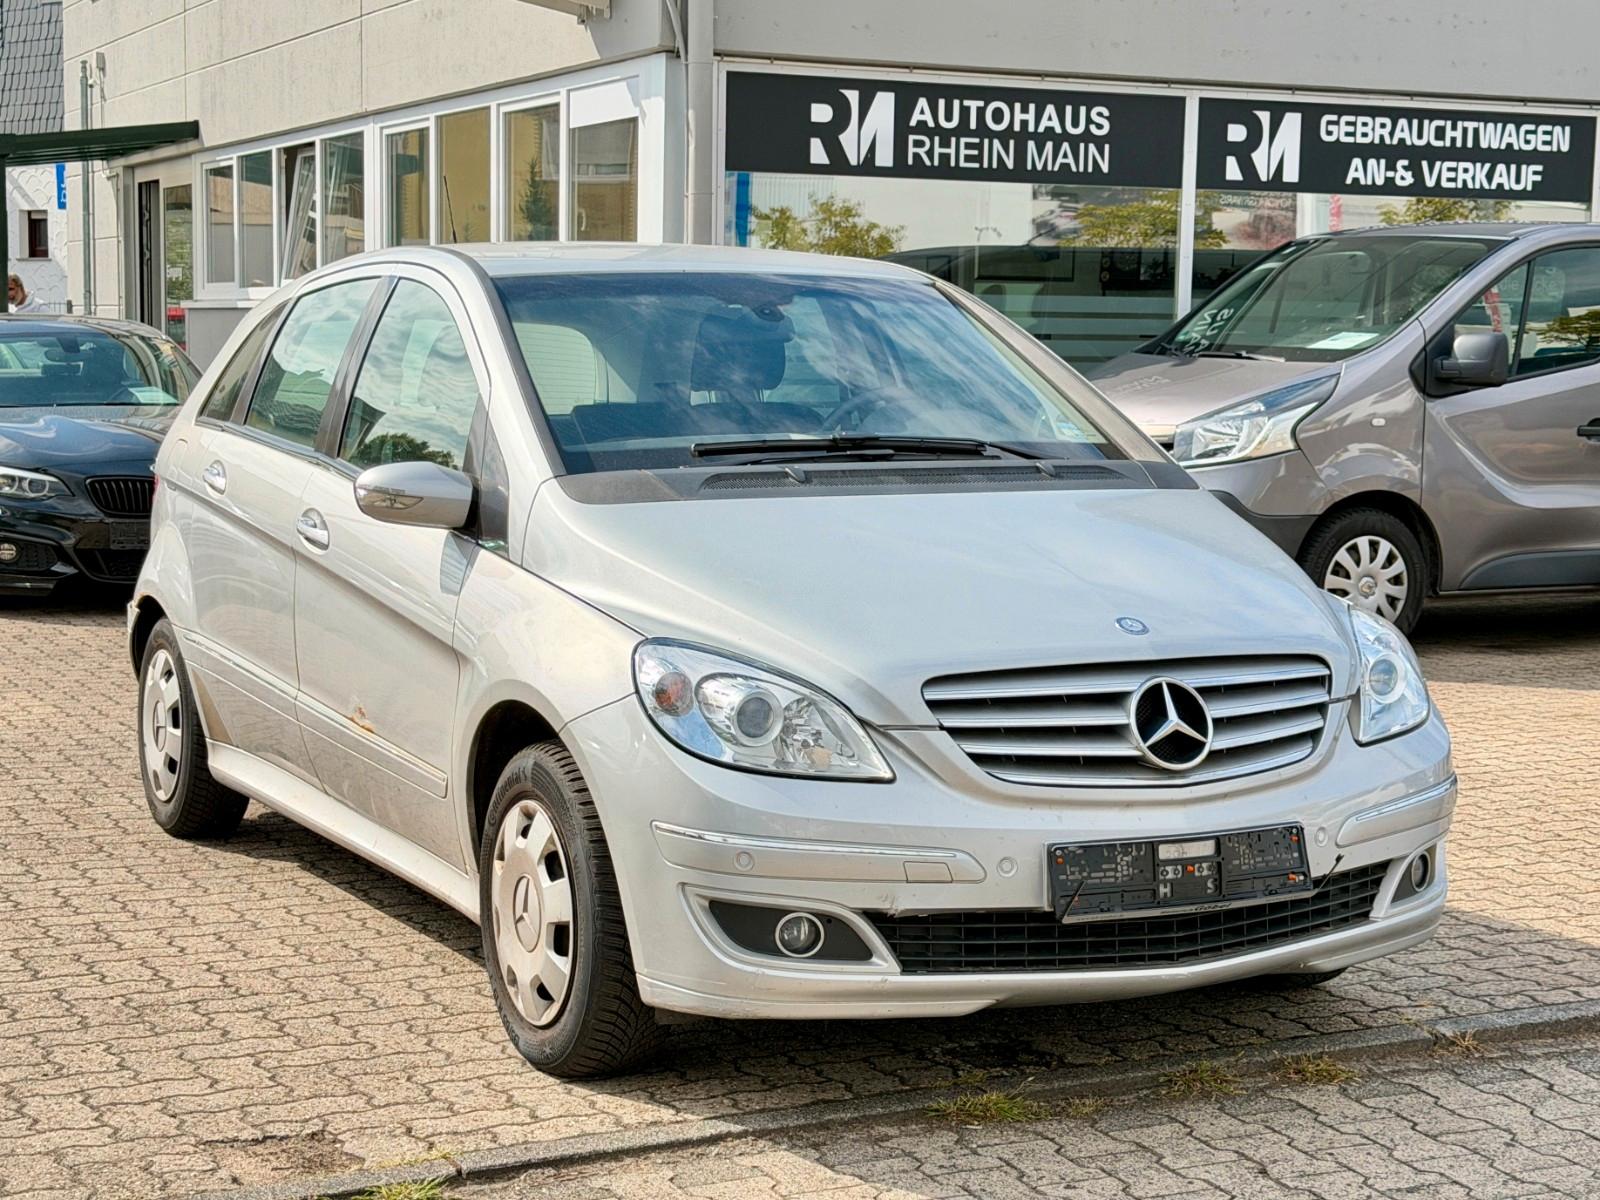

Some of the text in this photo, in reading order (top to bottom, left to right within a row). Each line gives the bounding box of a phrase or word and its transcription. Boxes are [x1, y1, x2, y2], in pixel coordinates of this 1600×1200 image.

[809, 89, 896, 168] RM
[908, 97, 1112, 136] AUTOHAUS
[1319, 114, 1571, 153] GEBRAUCHTWAGEN
[906, 134, 1111, 174] RHEIN MAIN
[1225, 110, 1302, 183] RM
[1345, 157, 1545, 191] AN-& VERKAUF
